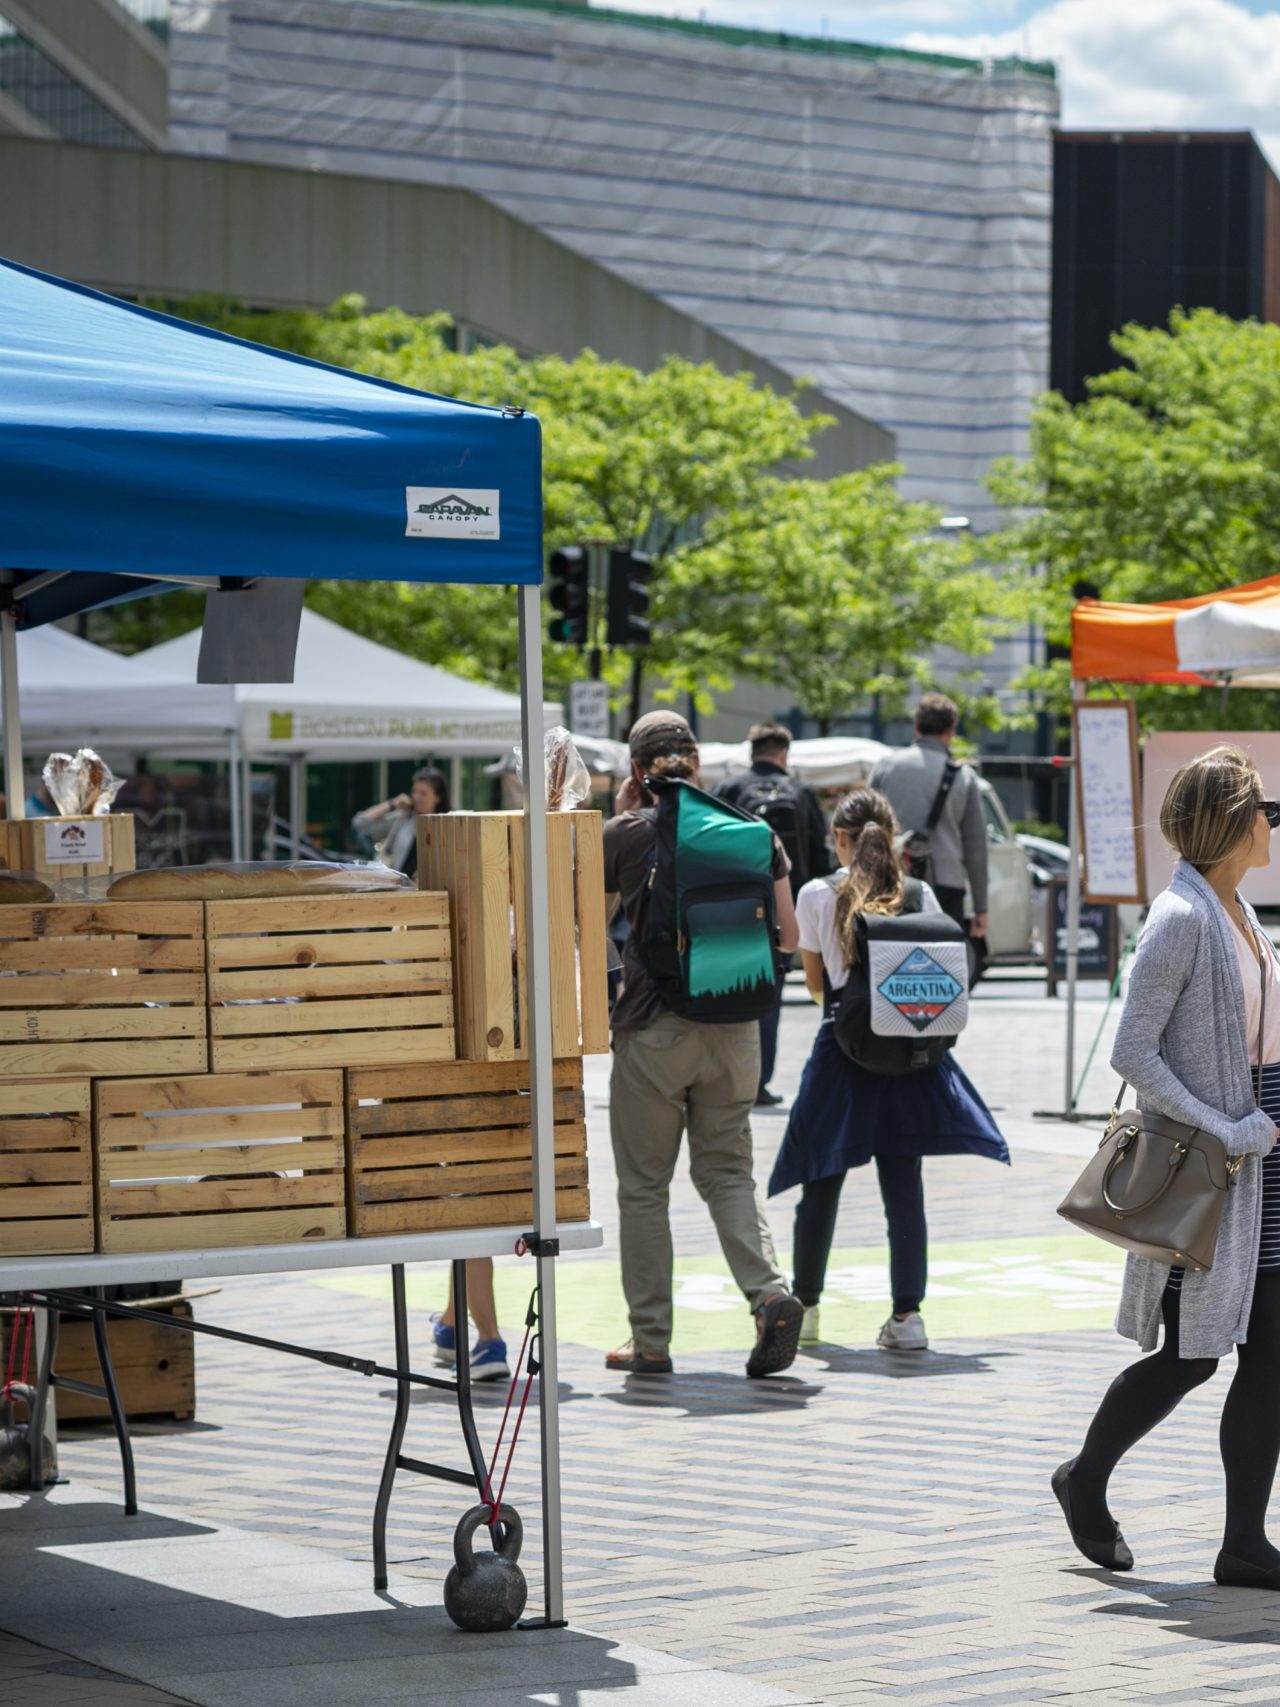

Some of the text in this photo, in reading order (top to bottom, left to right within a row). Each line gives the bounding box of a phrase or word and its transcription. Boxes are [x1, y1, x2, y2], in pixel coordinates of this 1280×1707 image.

[415, 503, 491, 516] CARAVAN
[428, 514, 479, 522] CANOPY
[887, 982, 955, 997] ARGENTINA
